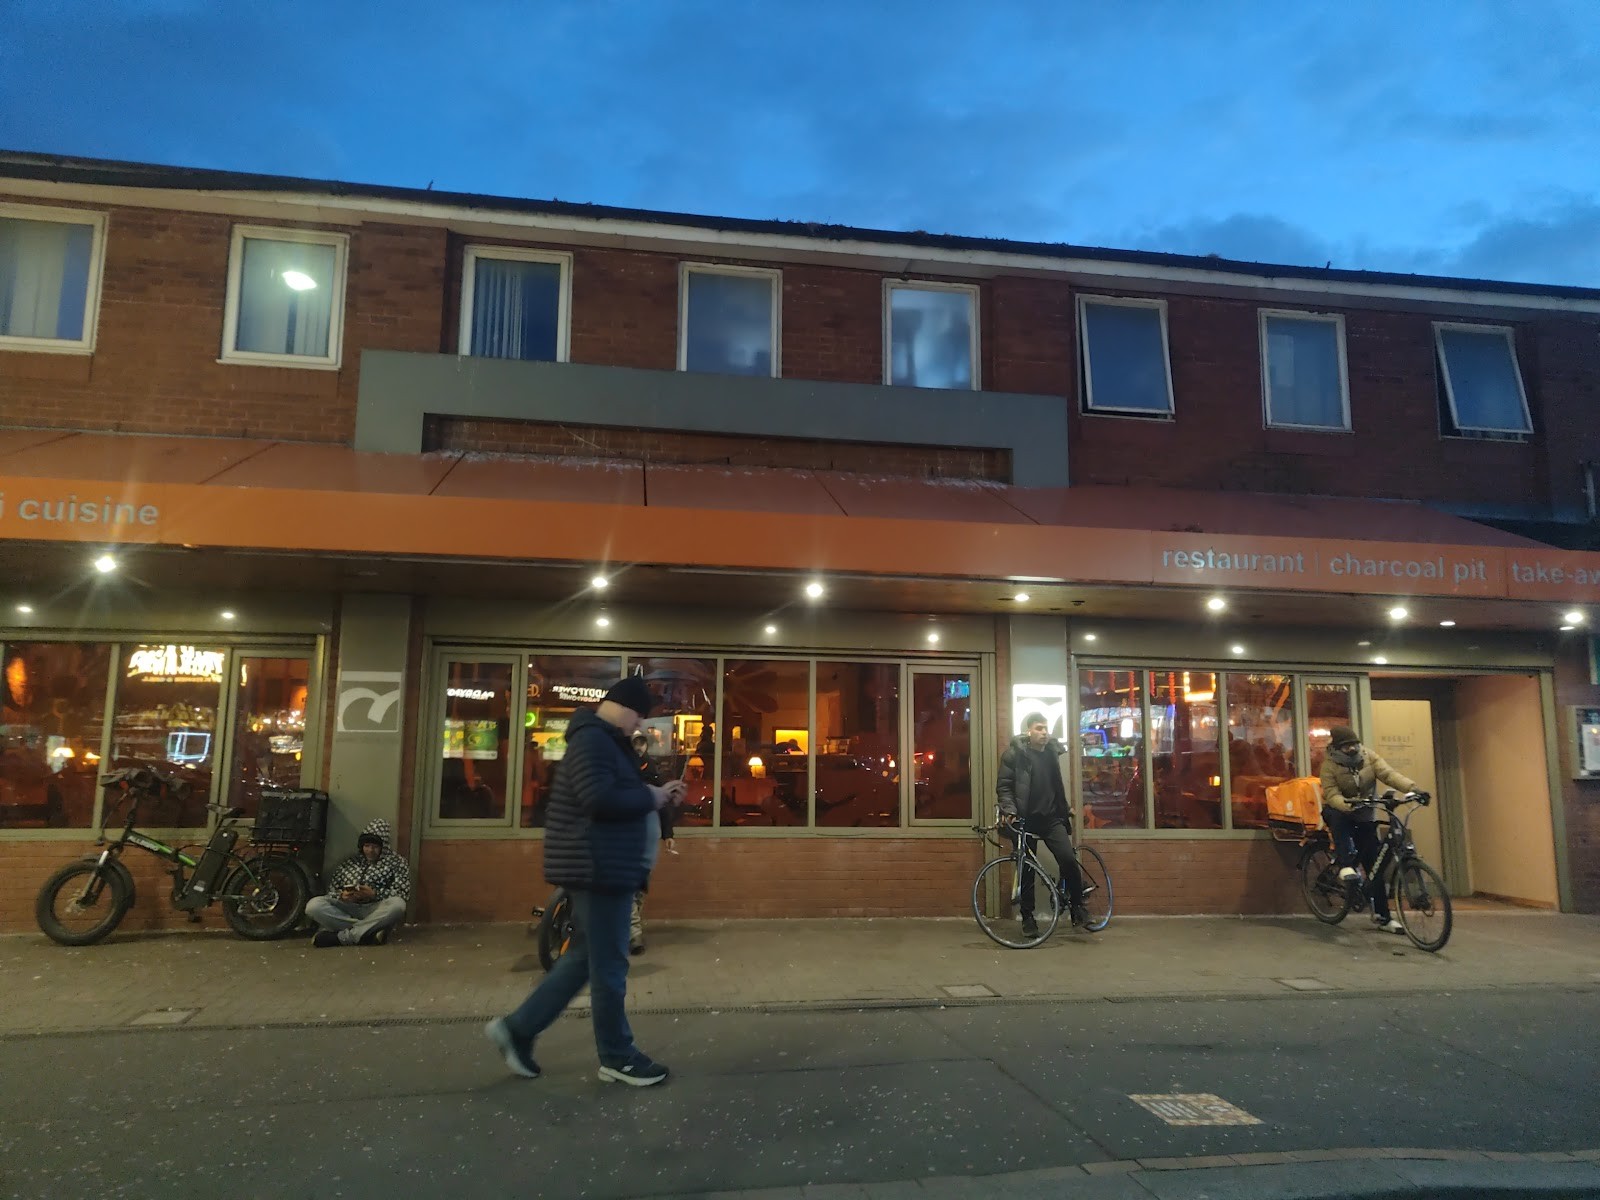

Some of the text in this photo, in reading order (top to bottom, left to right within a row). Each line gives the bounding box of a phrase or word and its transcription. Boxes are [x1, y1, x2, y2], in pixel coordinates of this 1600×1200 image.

[18, 494, 159, 525] cuisine
[1162, 547, 1305, 573] restaurant
[1329, 552, 1445, 579] charcoal
[1454, 558, 1487, 584] pit
